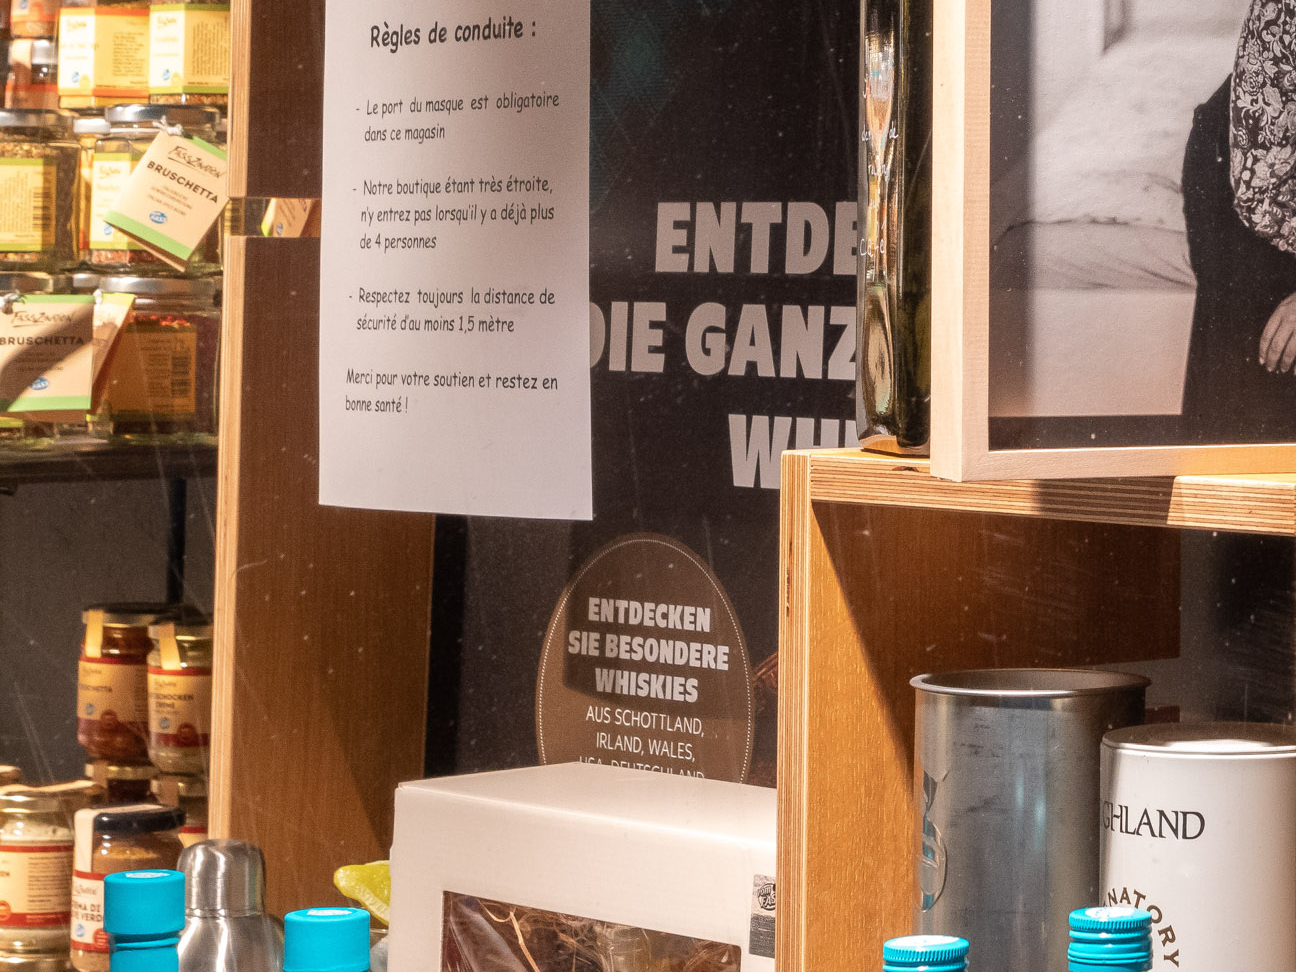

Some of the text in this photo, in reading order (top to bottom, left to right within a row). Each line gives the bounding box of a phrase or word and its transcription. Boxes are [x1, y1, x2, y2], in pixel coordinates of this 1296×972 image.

[371, 22, 420, 53] Règles
[428, 21, 447, 44] de
[454, 16, 523, 42] conduite
[366, 100, 379, 116] Le
[381, 100, 403, 119] port
[410, 97, 422, 113] du
[425, 98, 464, 119] masque
[470, 94, 488, 110] est
[496, 91, 560, 113] obligatoire
[364, 123, 445, 144] dans ce magasin
[147, 161, 218, 203] BRUSCHETTA
[363, 180, 393, 195] Notre
[396, 178, 442, 198] boutique
[445, 176, 475, 194] étant
[478, 176, 502, 193] très
[506, 175, 553, 195] étroite,
[360, 202, 555, 226] n'y entrez pas lorsqu'il y a déjà plus
[359, 233, 437, 253] de 4 personnes
[655, 201, 857, 276] ENTDE
[358, 287, 410, 308] Respectez
[417, 288, 463, 308] toujours
[471, 288, 480, 304] la
[484, 287, 535, 305] distance
[539, 288, 556, 305] de
[356, 313, 515, 334] sécurité d'au moins 1,5 mètre
[0, 336, 84, 346] BRUSCHETTA
[685, 302, 857, 381] GANZ
[346, 368, 558, 391] Merci pour votre soutien et restez en
[345, 395, 372, 412] bonne
[375, 396, 402, 413] santé
[588, 597, 711, 633] ENTDECKEN
[568, 630, 730, 671] SIE BESONDERE
[595, 667, 699, 703] WHISKIES
[586, 705, 705, 738] AUS SCHOTTLAND,
[596, 732, 696, 763] IRLAND, WALES,
[1102, 800, 1206, 840] GHLAND
[1103, 886, 1180, 968] NATORY
